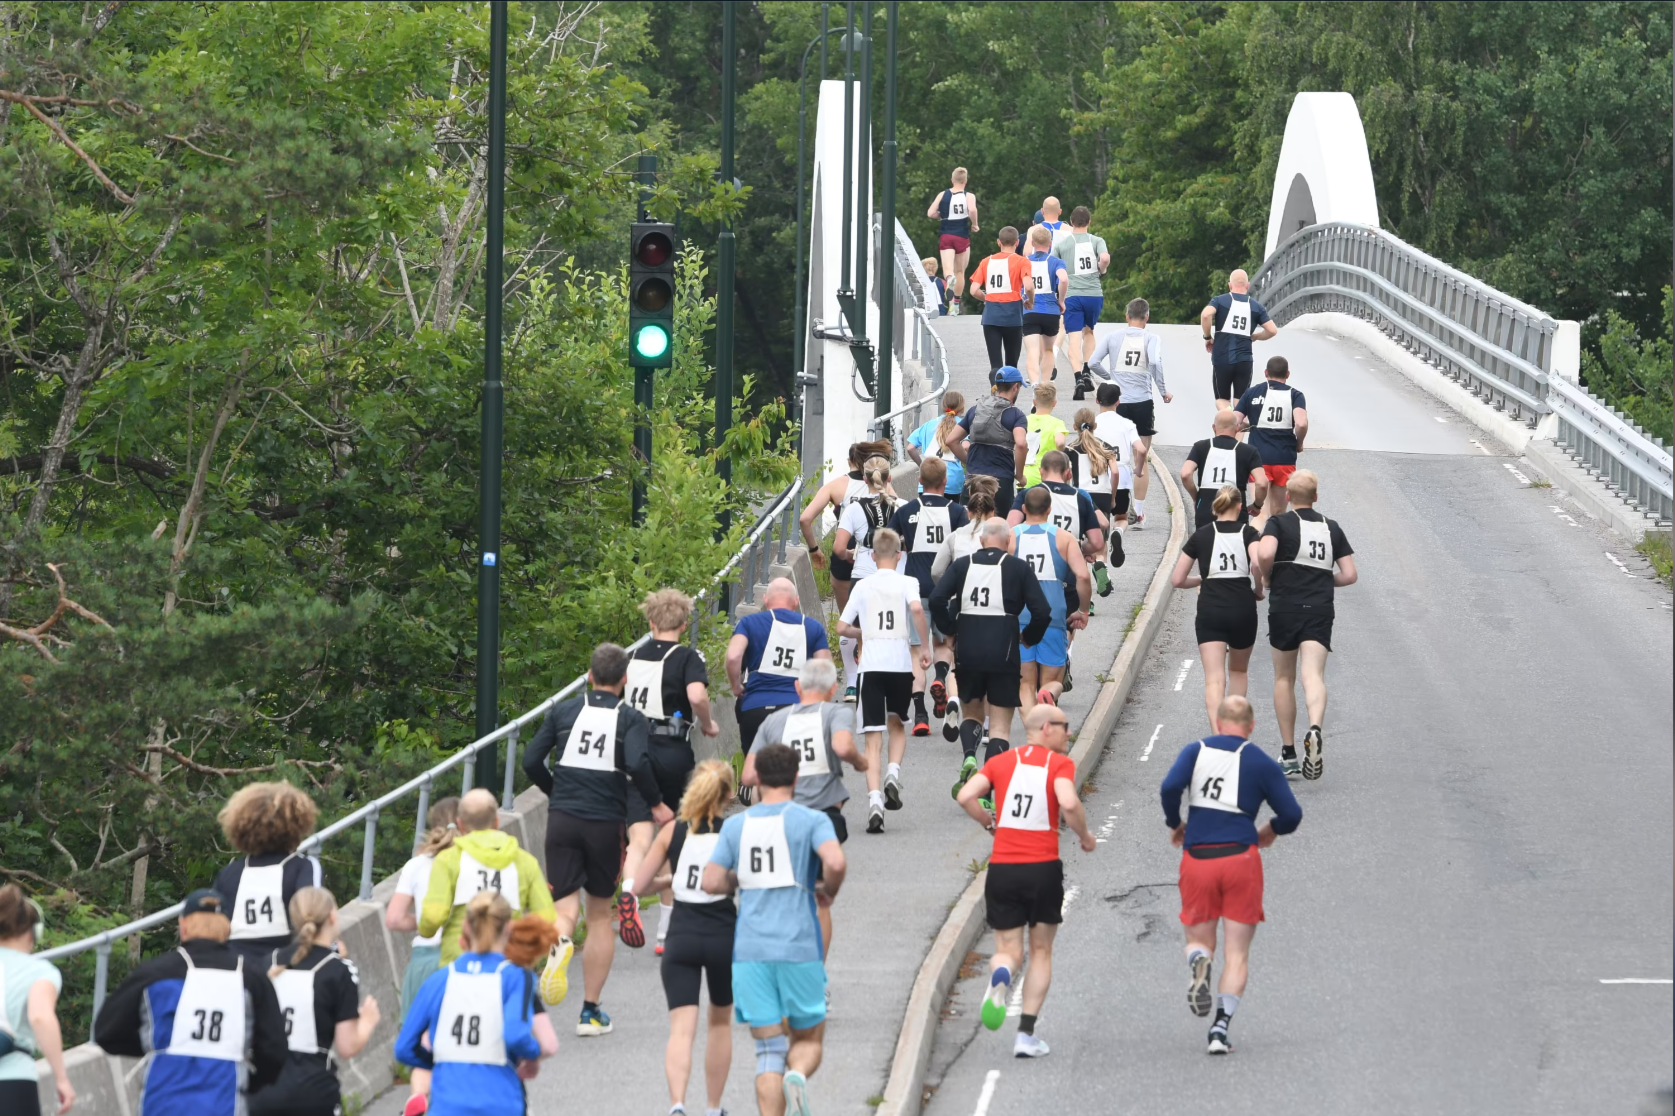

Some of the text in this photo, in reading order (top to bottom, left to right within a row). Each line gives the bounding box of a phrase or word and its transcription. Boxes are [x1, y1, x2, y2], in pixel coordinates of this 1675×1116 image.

[953, 203, 964, 214] 63
[1079, 256, 1092, 270] 36
[990, 274, 1002, 288] 40
[1232, 315, 1246, 330] 59
[1125, 350, 1141, 366] 57
[1267, 406, 1282, 422] 30
[1212, 467, 1226, 483] 11
[926, 526, 944, 544] 50
[1309, 540, 1326, 560] 33
[1026, 554, 1045, 573] 67
[1220, 552, 1237, 571] 31
[970, 586, 990, 607] 43
[878, 610, 894, 630] 19
[772, 646, 795, 669] 35
[630, 687, 648, 710] 44
[578, 730, 606, 758] 54
[1200, 776, 1224, 802] 45
[1012, 794, 1033, 818] 37
[750, 846, 774, 872] 61
[476, 869, 502, 895] 34
[686, 864, 700, 890] 6
[245, 896, 272, 925] 64
[191, 1008, 224, 1042] 38
[284, 1006, 294, 1036] 6
[451, 1014, 480, 1046] 48
